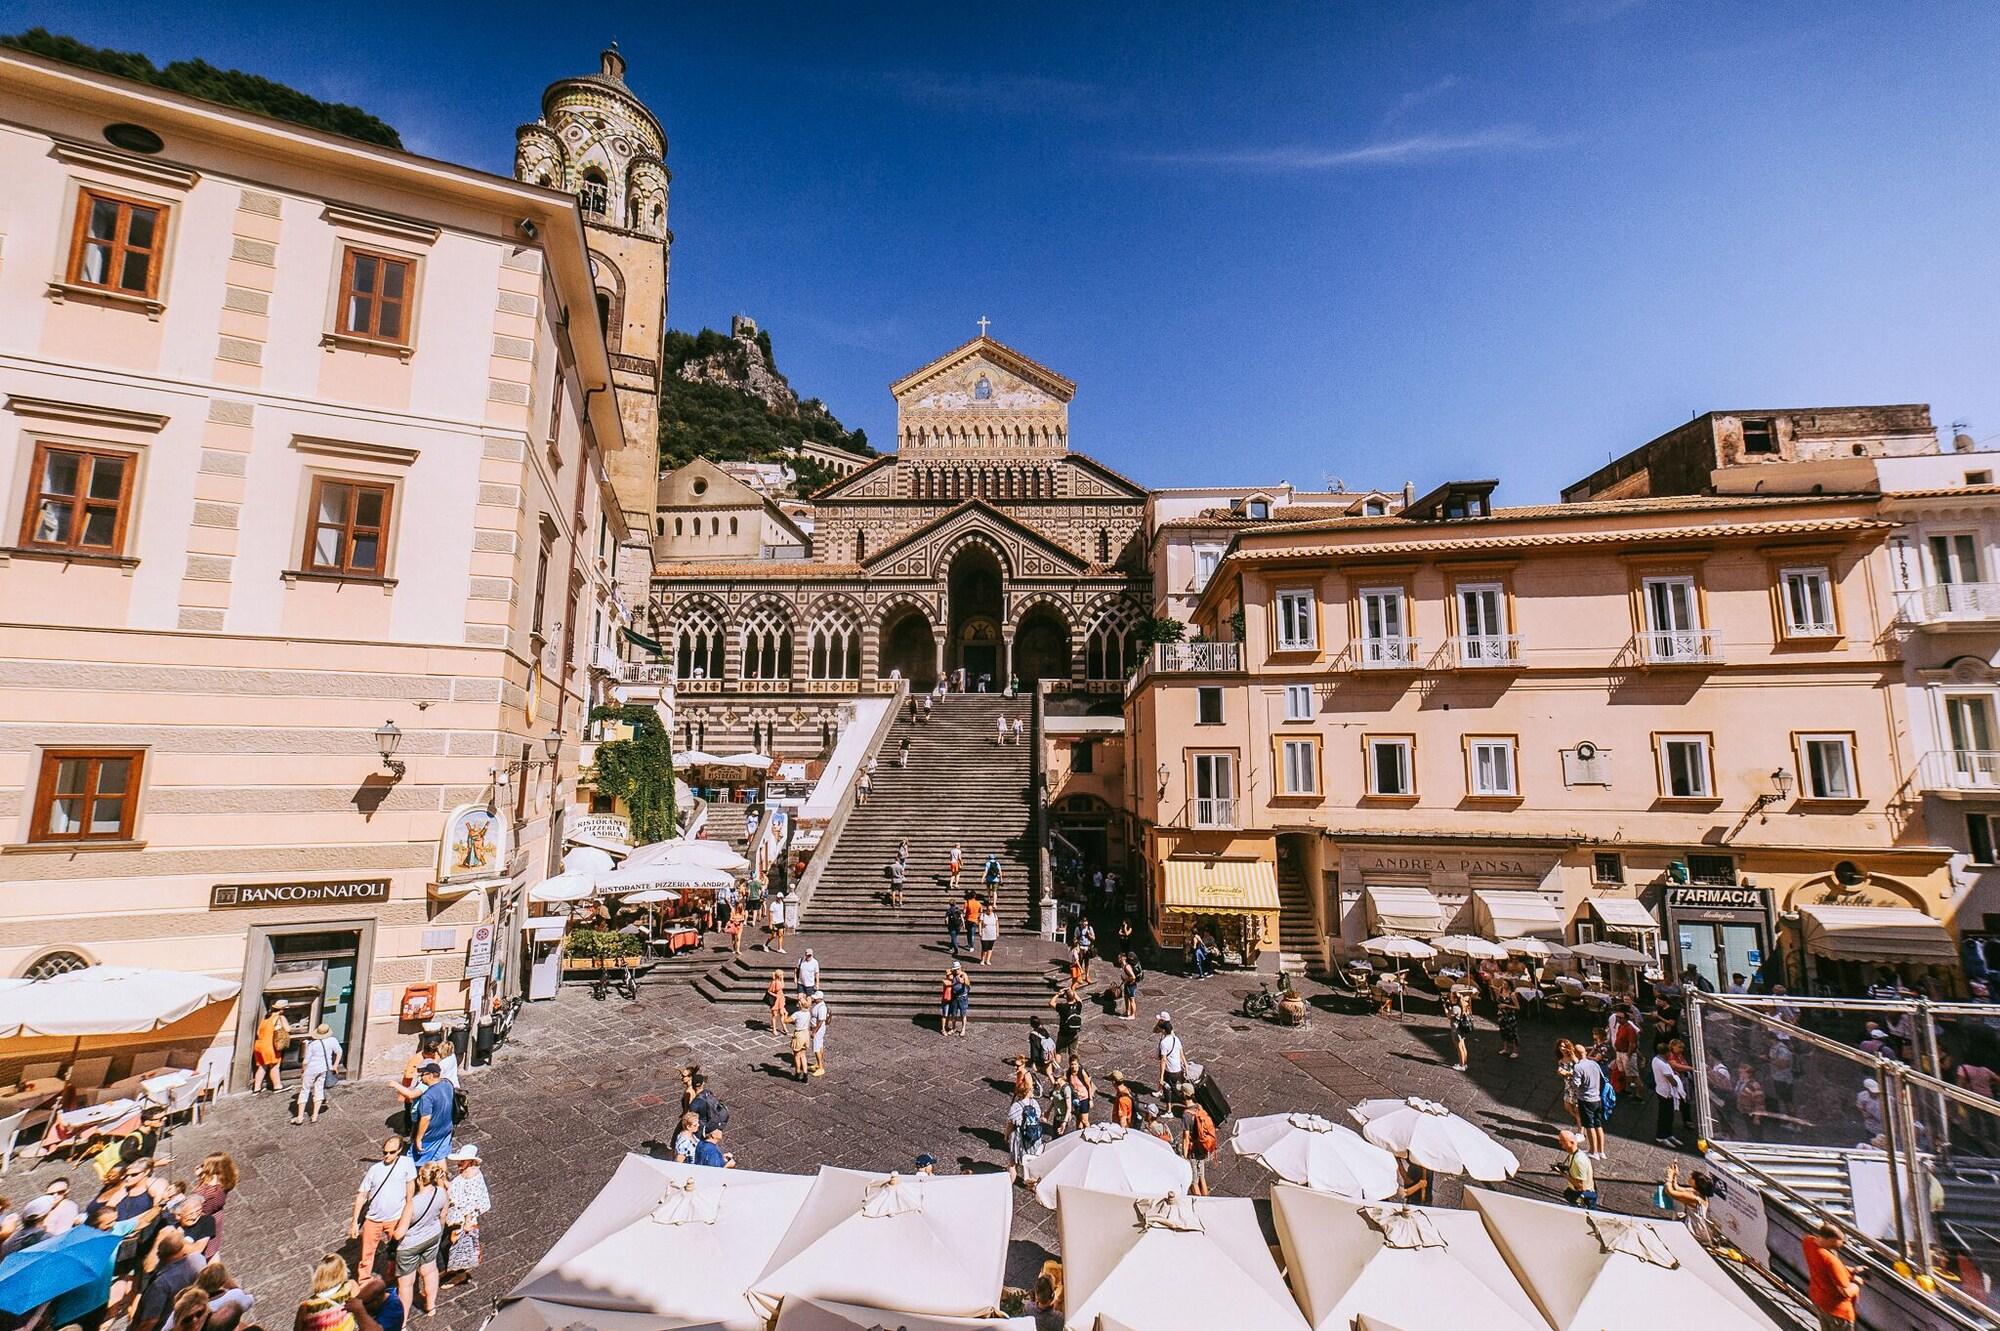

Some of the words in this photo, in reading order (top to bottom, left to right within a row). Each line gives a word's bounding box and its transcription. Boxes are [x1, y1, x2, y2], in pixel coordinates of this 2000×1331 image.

[577, 819, 627, 828] RISTORANTE
[1375, 857, 1447, 871] ANDREA
[1460, 859, 1524, 873] PANSA
[241, 886, 307, 902] BANCO
[307, 888, 322, 899] DI
[322, 883, 385, 899] NAPOLI
[599, 883, 651, 893] RISTORANTE
[655, 881, 690, 889] PIZZERIA
[1676, 888, 1760, 904] FARMACIA
